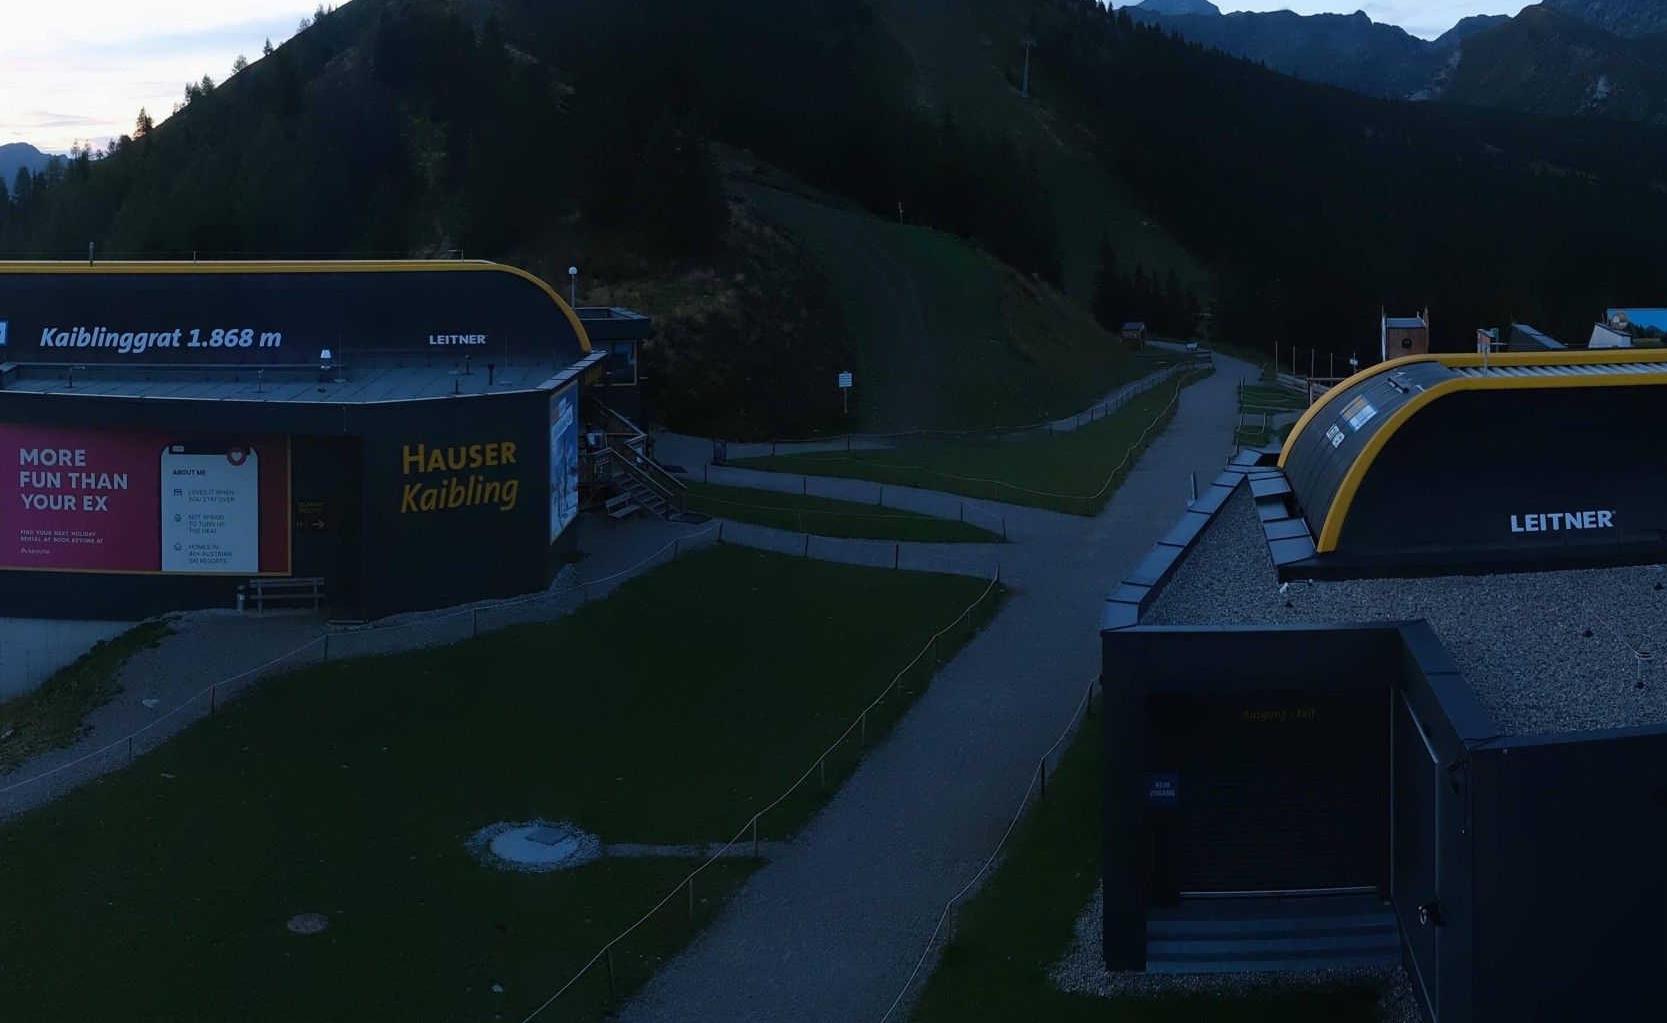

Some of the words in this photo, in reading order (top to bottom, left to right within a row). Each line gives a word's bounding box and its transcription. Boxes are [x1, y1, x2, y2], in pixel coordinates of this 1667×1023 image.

[39, 327, 181, 354] Kaiblinggrat
[187, 328, 254, 348] 1.868
[258, 332, 282, 348] m
[428, 334, 487, 346] LEITNER
[20, 448, 86, 467] MORE
[402, 441, 517, 475] HAUSER
[20, 471, 60, 488] FUN
[68, 472, 128, 490] THAN
[21, 493, 76, 511] YOUR
[83, 495, 108, 511] EX
[400, 475, 519, 513] Kaibling
[1510, 510, 1615, 533] LEITNER
[28, 547, 51, 555] keyone
[1242, 709, 1287, 722] Ausgang
[1296, 707, 1316, 719] Exit
[1150, 789, 1176, 797] ZUGANG
[1155, 781, 1170, 789] KEIN
